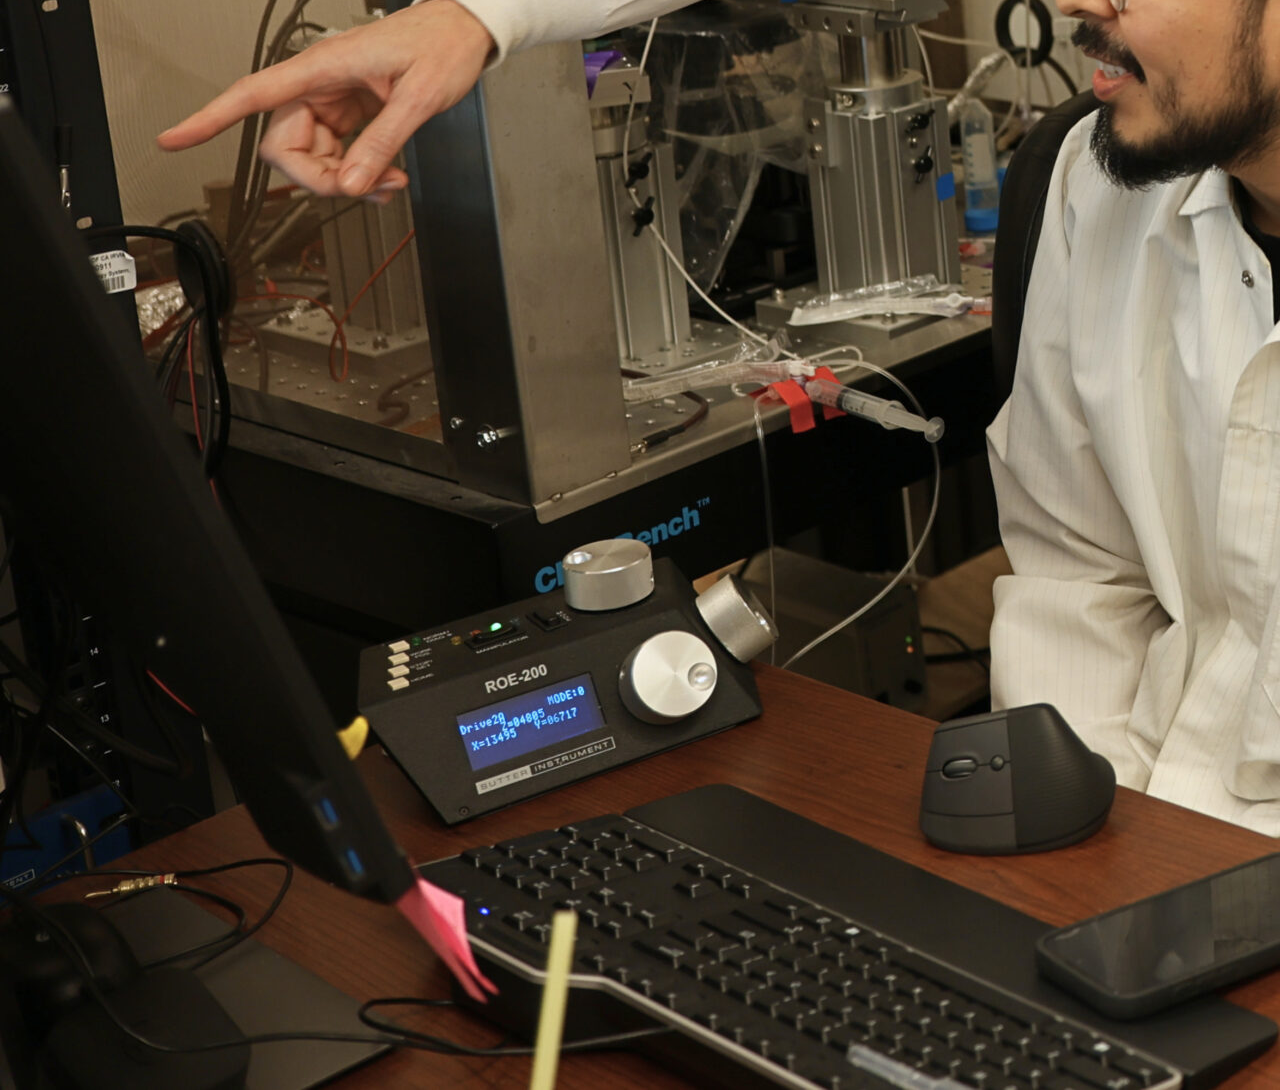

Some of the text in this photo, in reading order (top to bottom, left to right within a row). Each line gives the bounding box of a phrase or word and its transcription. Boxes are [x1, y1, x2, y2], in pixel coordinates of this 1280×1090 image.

[484, 663, 549, 694] ROE-200
[547, 685, 585, 706] MODE:0
[471, 706, 578, 752] X=13495 Y=06717
[480, 741, 611, 791] SUTTER INSTRUMENT
